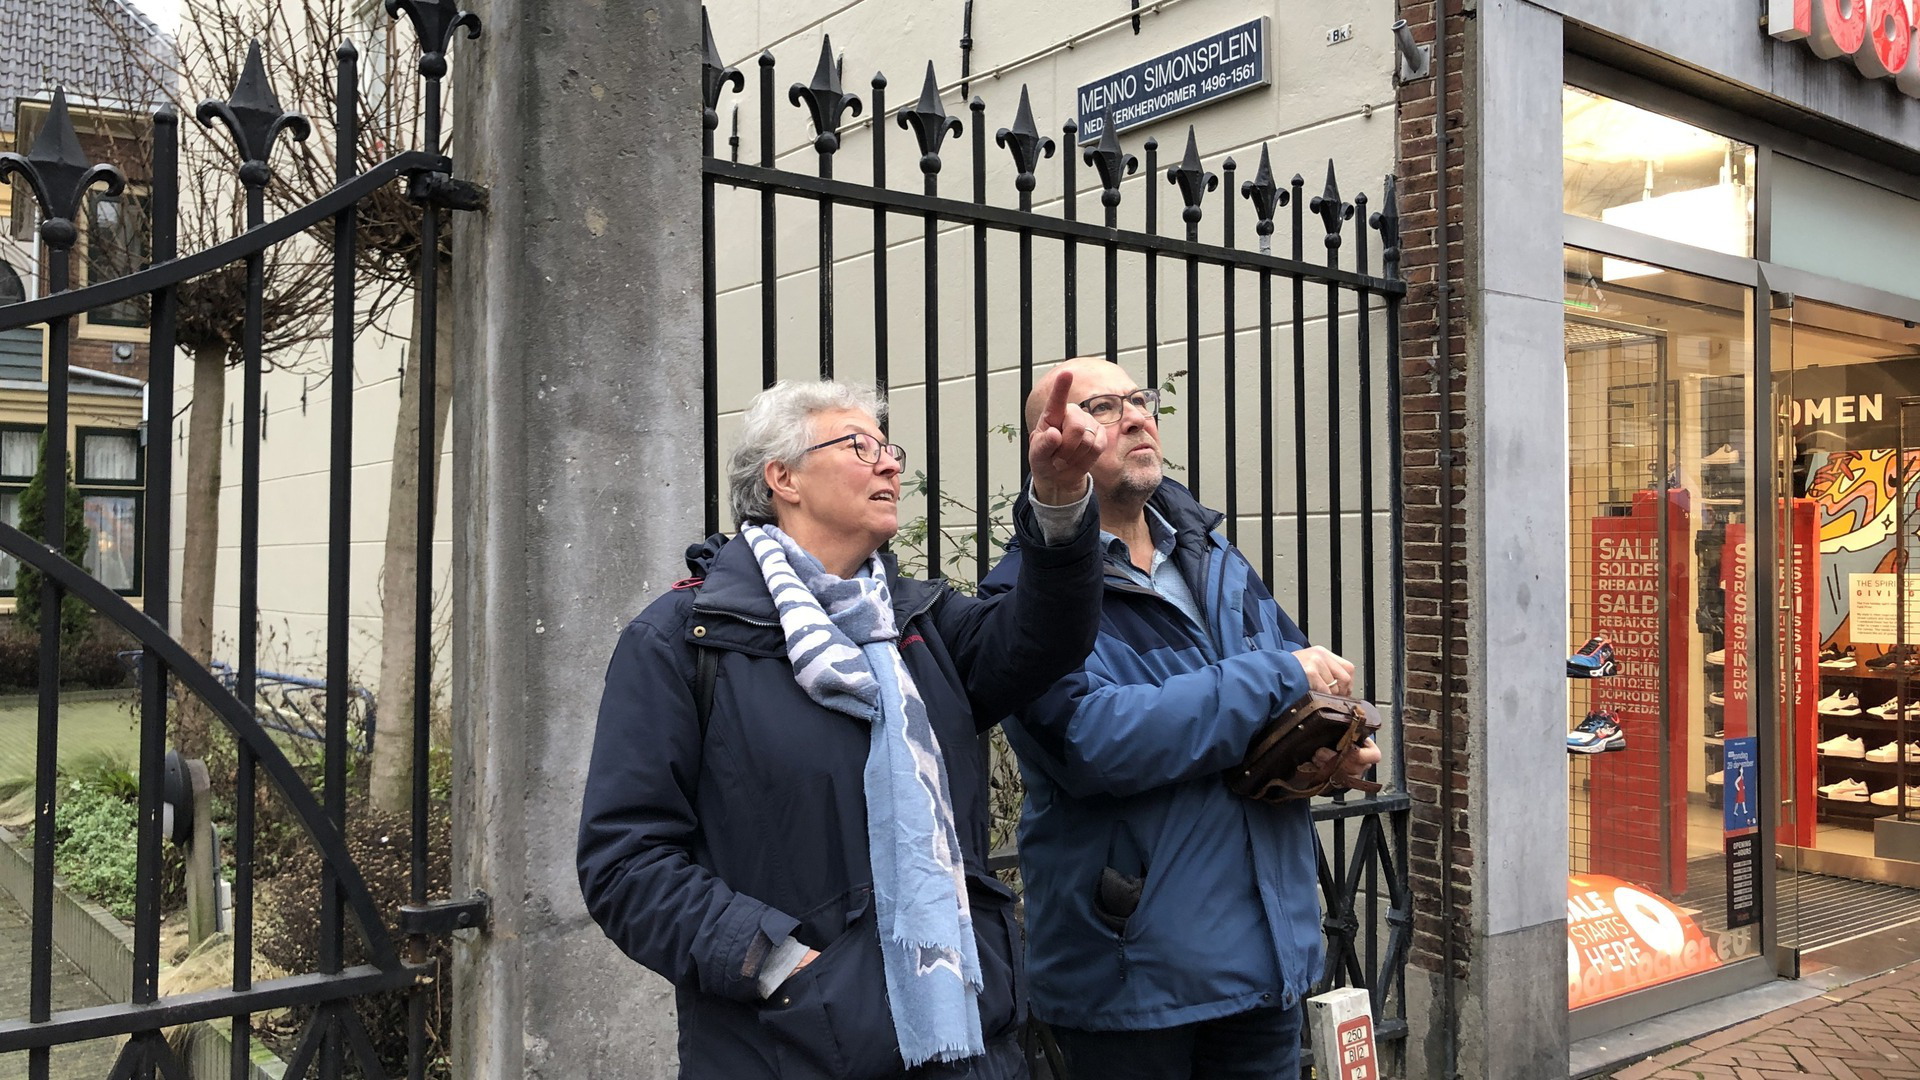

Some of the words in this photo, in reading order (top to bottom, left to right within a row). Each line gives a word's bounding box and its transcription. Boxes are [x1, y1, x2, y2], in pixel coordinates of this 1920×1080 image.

[1081, 74, 1137, 116] MENNO
[1144, 28, 1257, 92] SIMONSPLEIN
[1200, 61, 1255, 94] 1496-1561
[1780, 393, 1883, 426] OMEN
[1599, 537, 1659, 560] SALE
[1856, 579, 1873, 588] THE
[1874, 579, 1897, 588] SPIRI
[1856, 589, 1915, 597] GIVIG
[1598, 593, 1659, 615] SALD
[1599, 688, 1659, 703] DOPRODE
[1570, 916, 1630, 946] STARTS
[1584, 936, 1643, 976] HERE
[1347, 1028, 1362, 1042] 250
[1358, 1047, 1364, 1059] 2
[1356, 1067, 1362, 1079] 2
